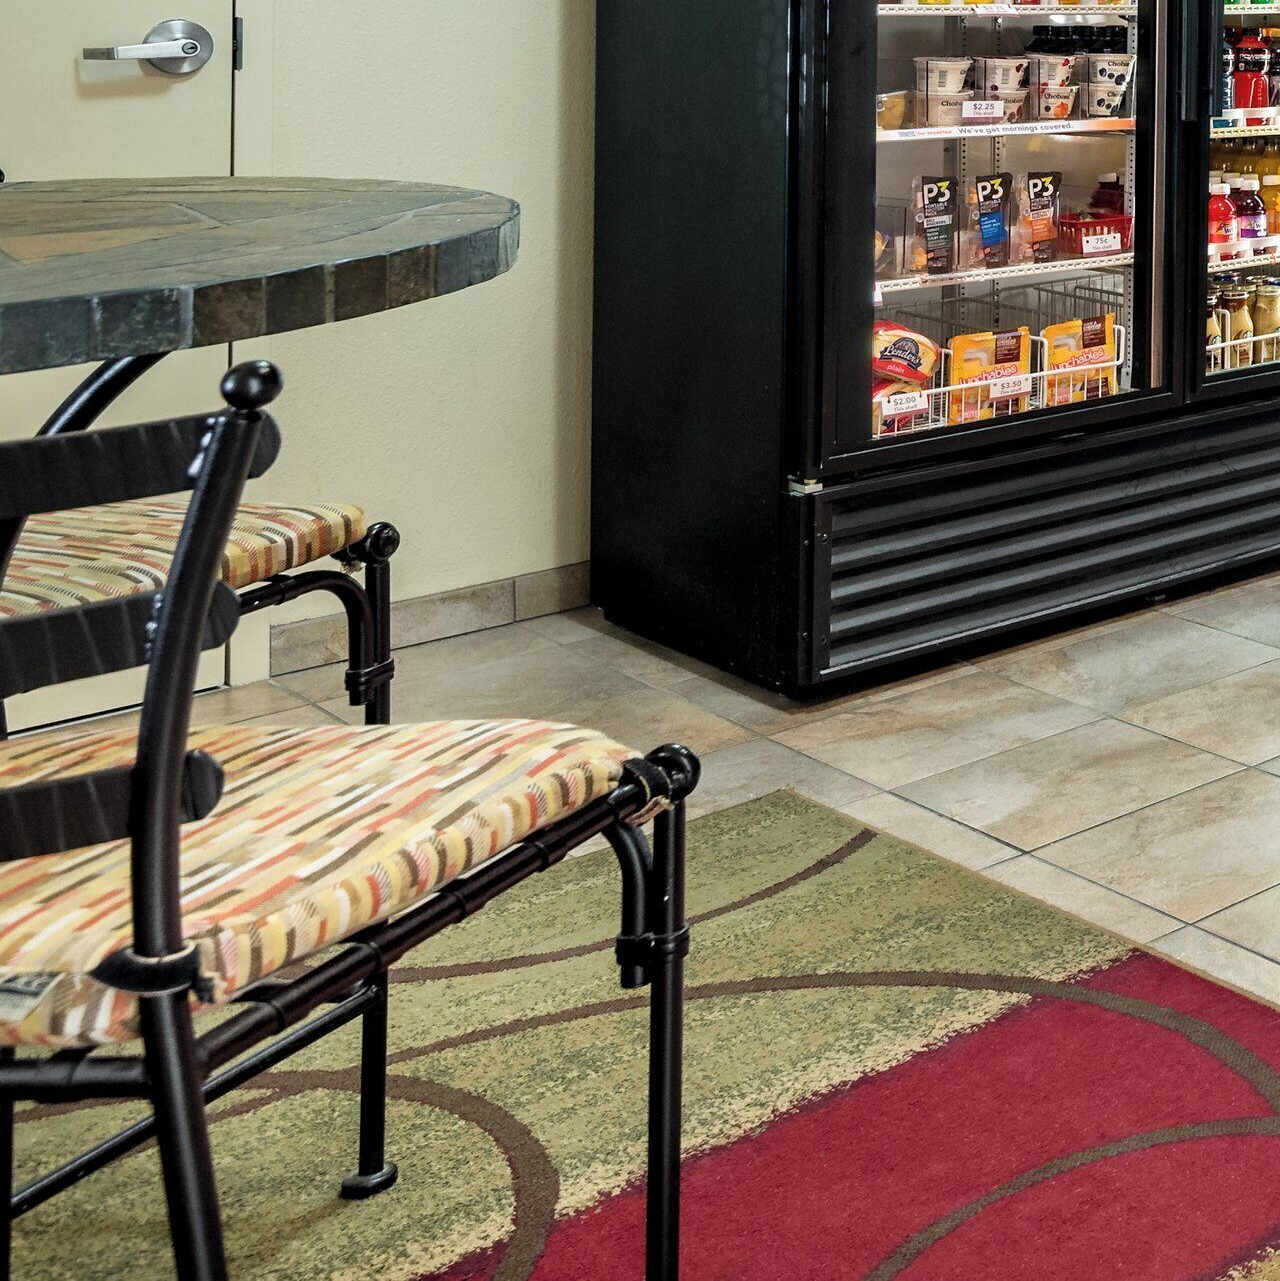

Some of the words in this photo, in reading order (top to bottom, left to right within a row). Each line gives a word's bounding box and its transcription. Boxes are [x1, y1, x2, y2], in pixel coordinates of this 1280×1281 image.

[958, 127, 983, 135] We've
[985, 126, 1001, 134] got
[1002, 124, 1038, 134] mornings
[1040, 122, 1074, 130] covered.
[924, 181, 950, 204] P3
[977, 178, 1004, 202] P3
[1029, 176, 1054, 199] P3
[887, 364, 905, 373] plain
[1000, 380, 1022, 389] $3.50
[893, 396, 916, 405] $2.00
